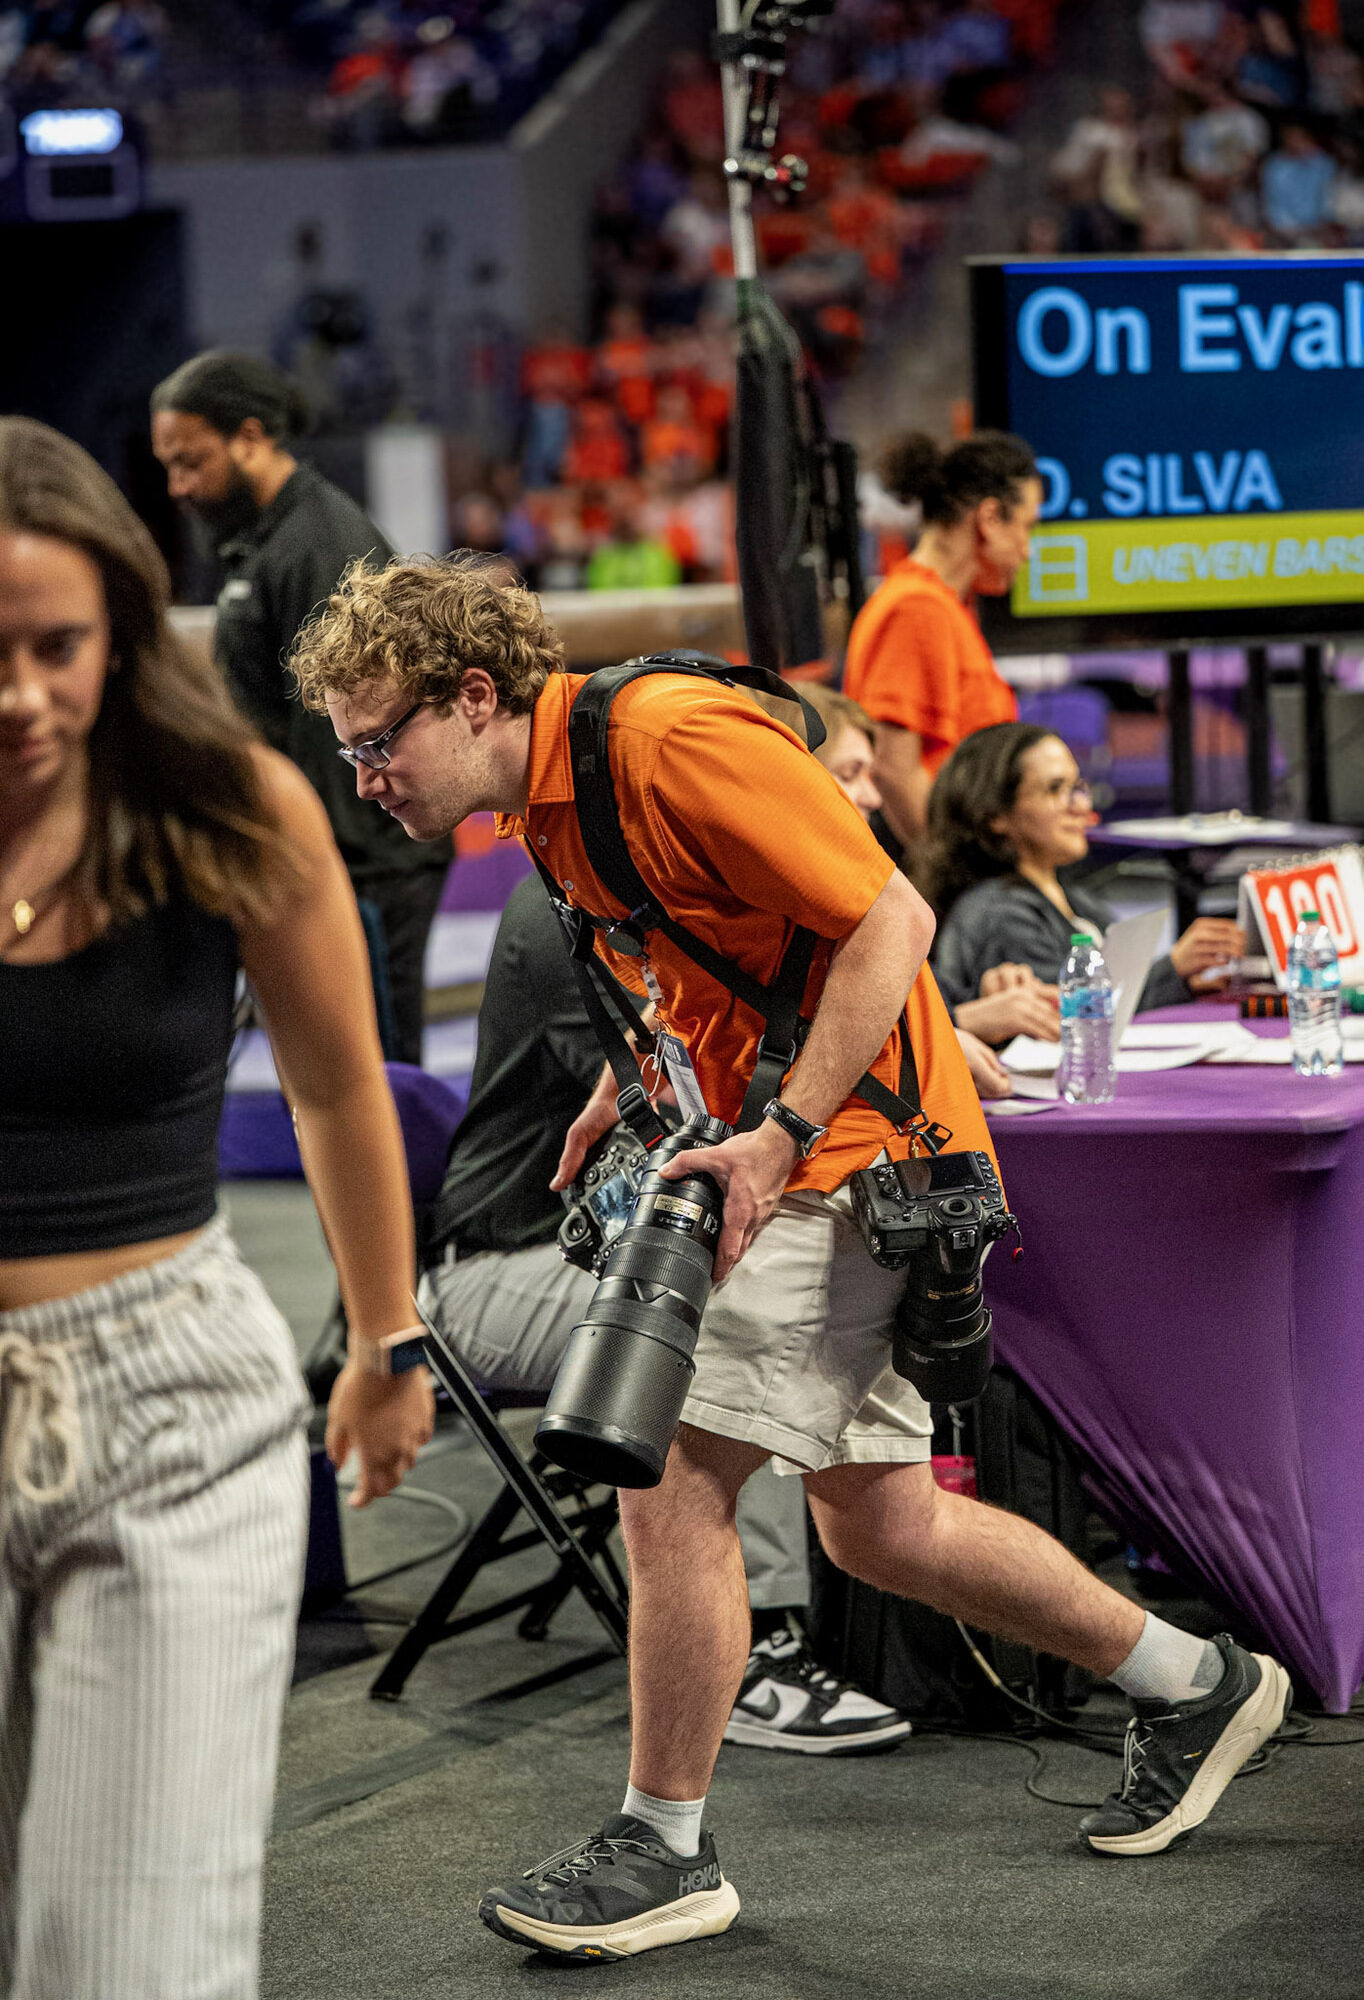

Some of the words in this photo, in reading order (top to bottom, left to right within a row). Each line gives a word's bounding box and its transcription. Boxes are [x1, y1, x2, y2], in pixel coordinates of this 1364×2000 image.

[1017, 285, 1151, 378] On
[1178, 280, 1364, 373] Eval
[1102, 449, 1284, 517] SILVA
[1112, 540, 1269, 585] UNEVEN
[1274, 533, 1364, 577] BARS
[678, 1862, 721, 1897] HOKA
